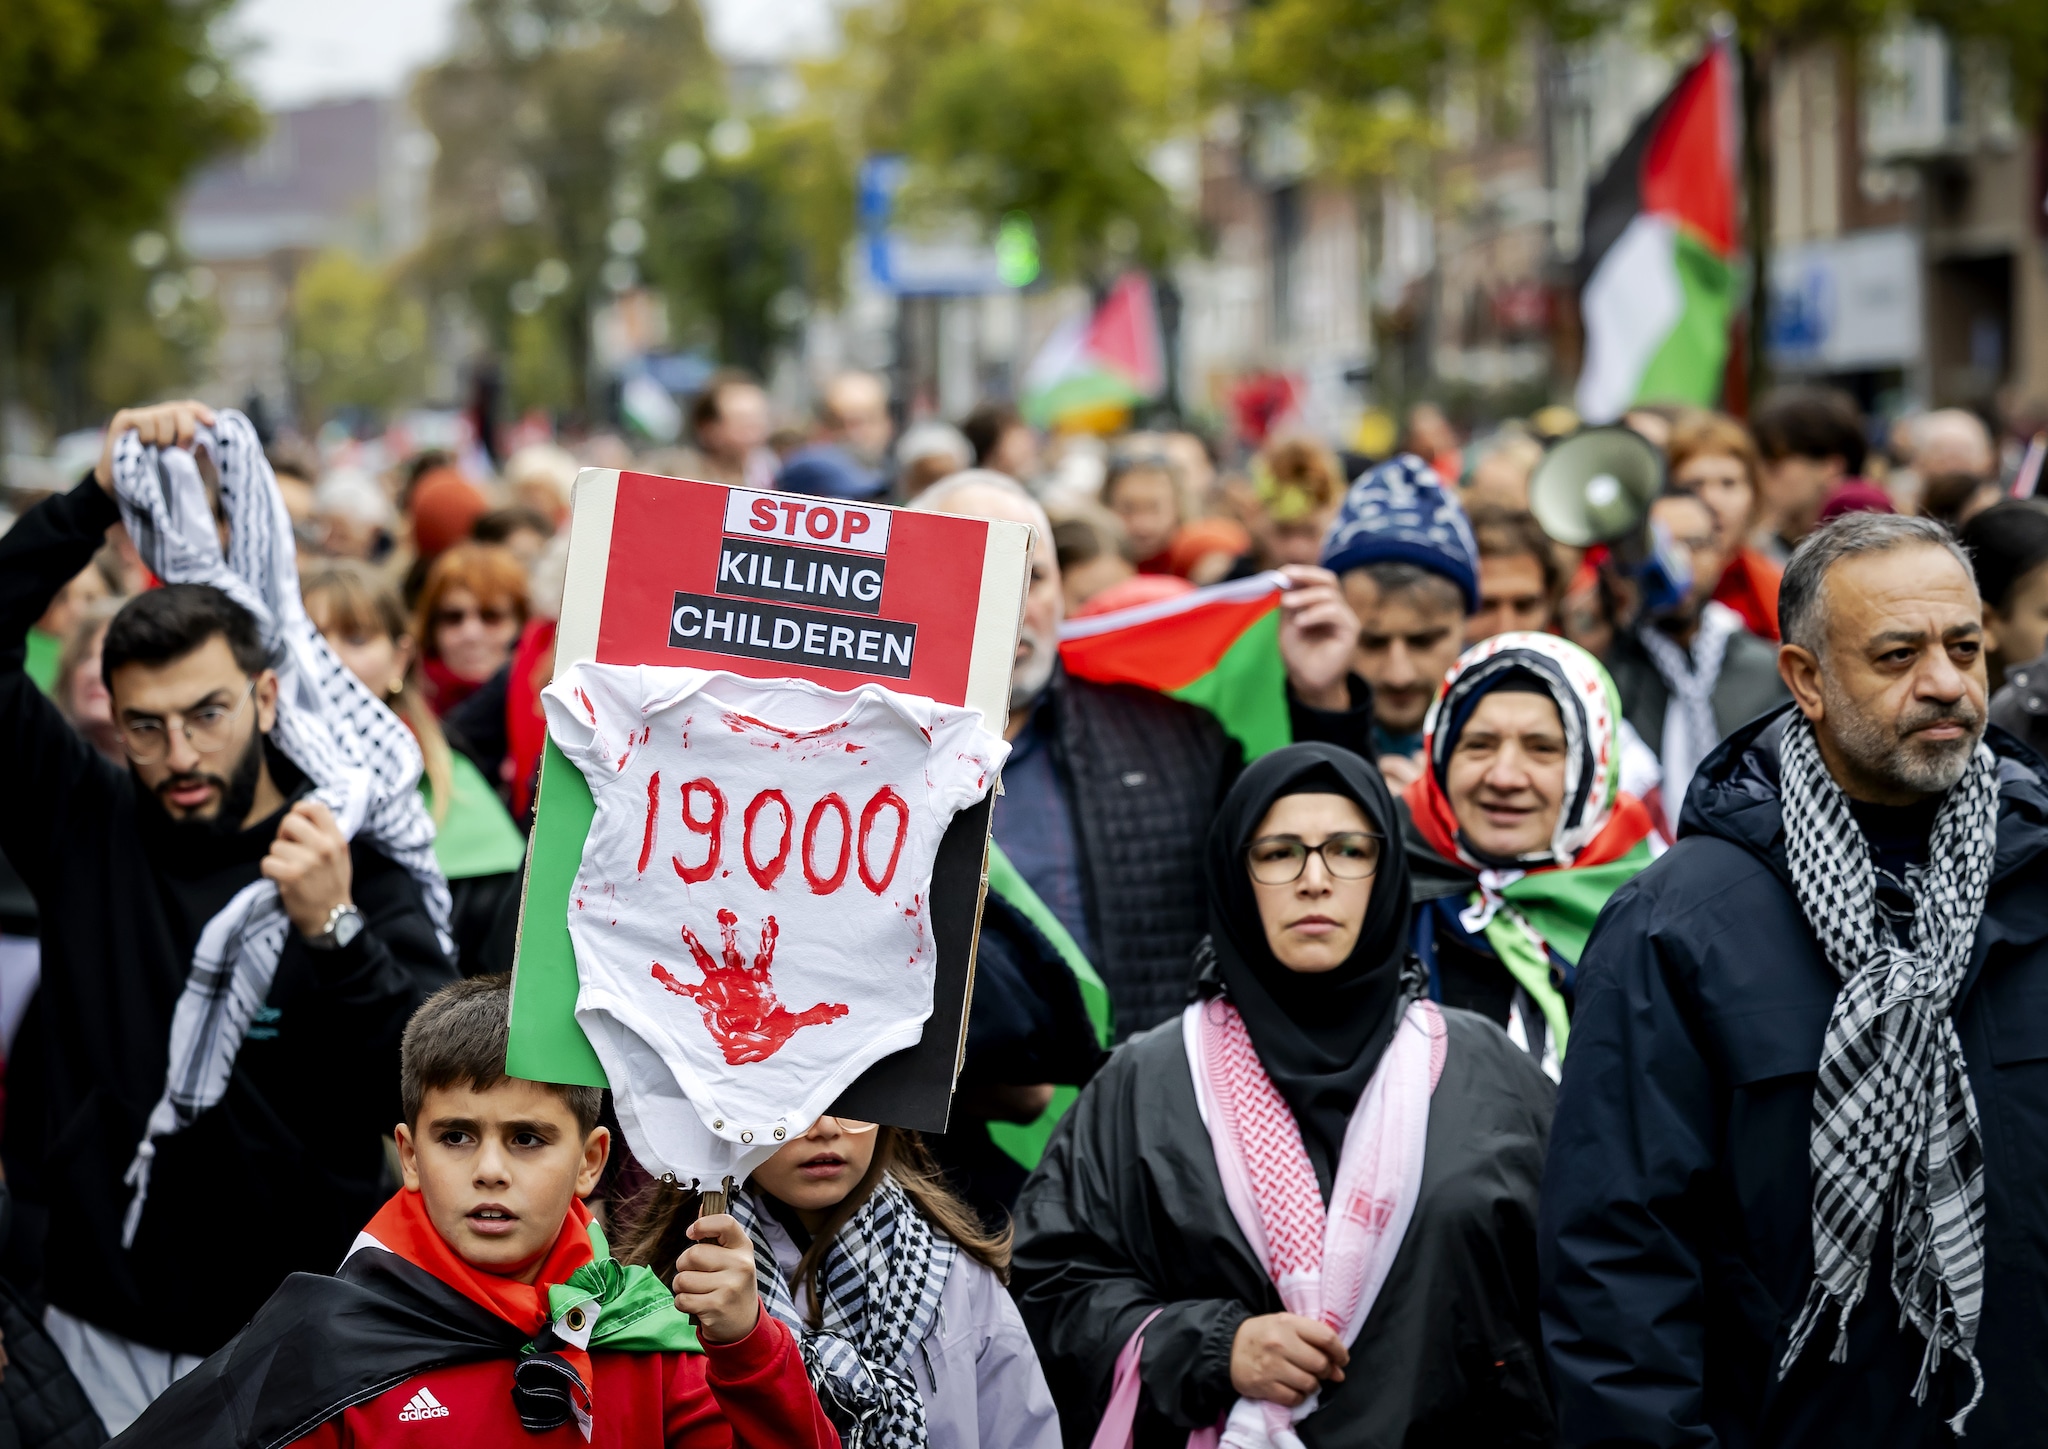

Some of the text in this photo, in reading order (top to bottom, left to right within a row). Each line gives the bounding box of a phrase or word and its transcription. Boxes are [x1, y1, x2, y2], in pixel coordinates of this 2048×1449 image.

[750, 498, 870, 543] STOP
[719, 550, 881, 601] KILLING
[672, 605, 913, 667] CHILDEREN
[636, 770, 910, 897] 19.000
[399, 1406, 449, 1421] adidas
